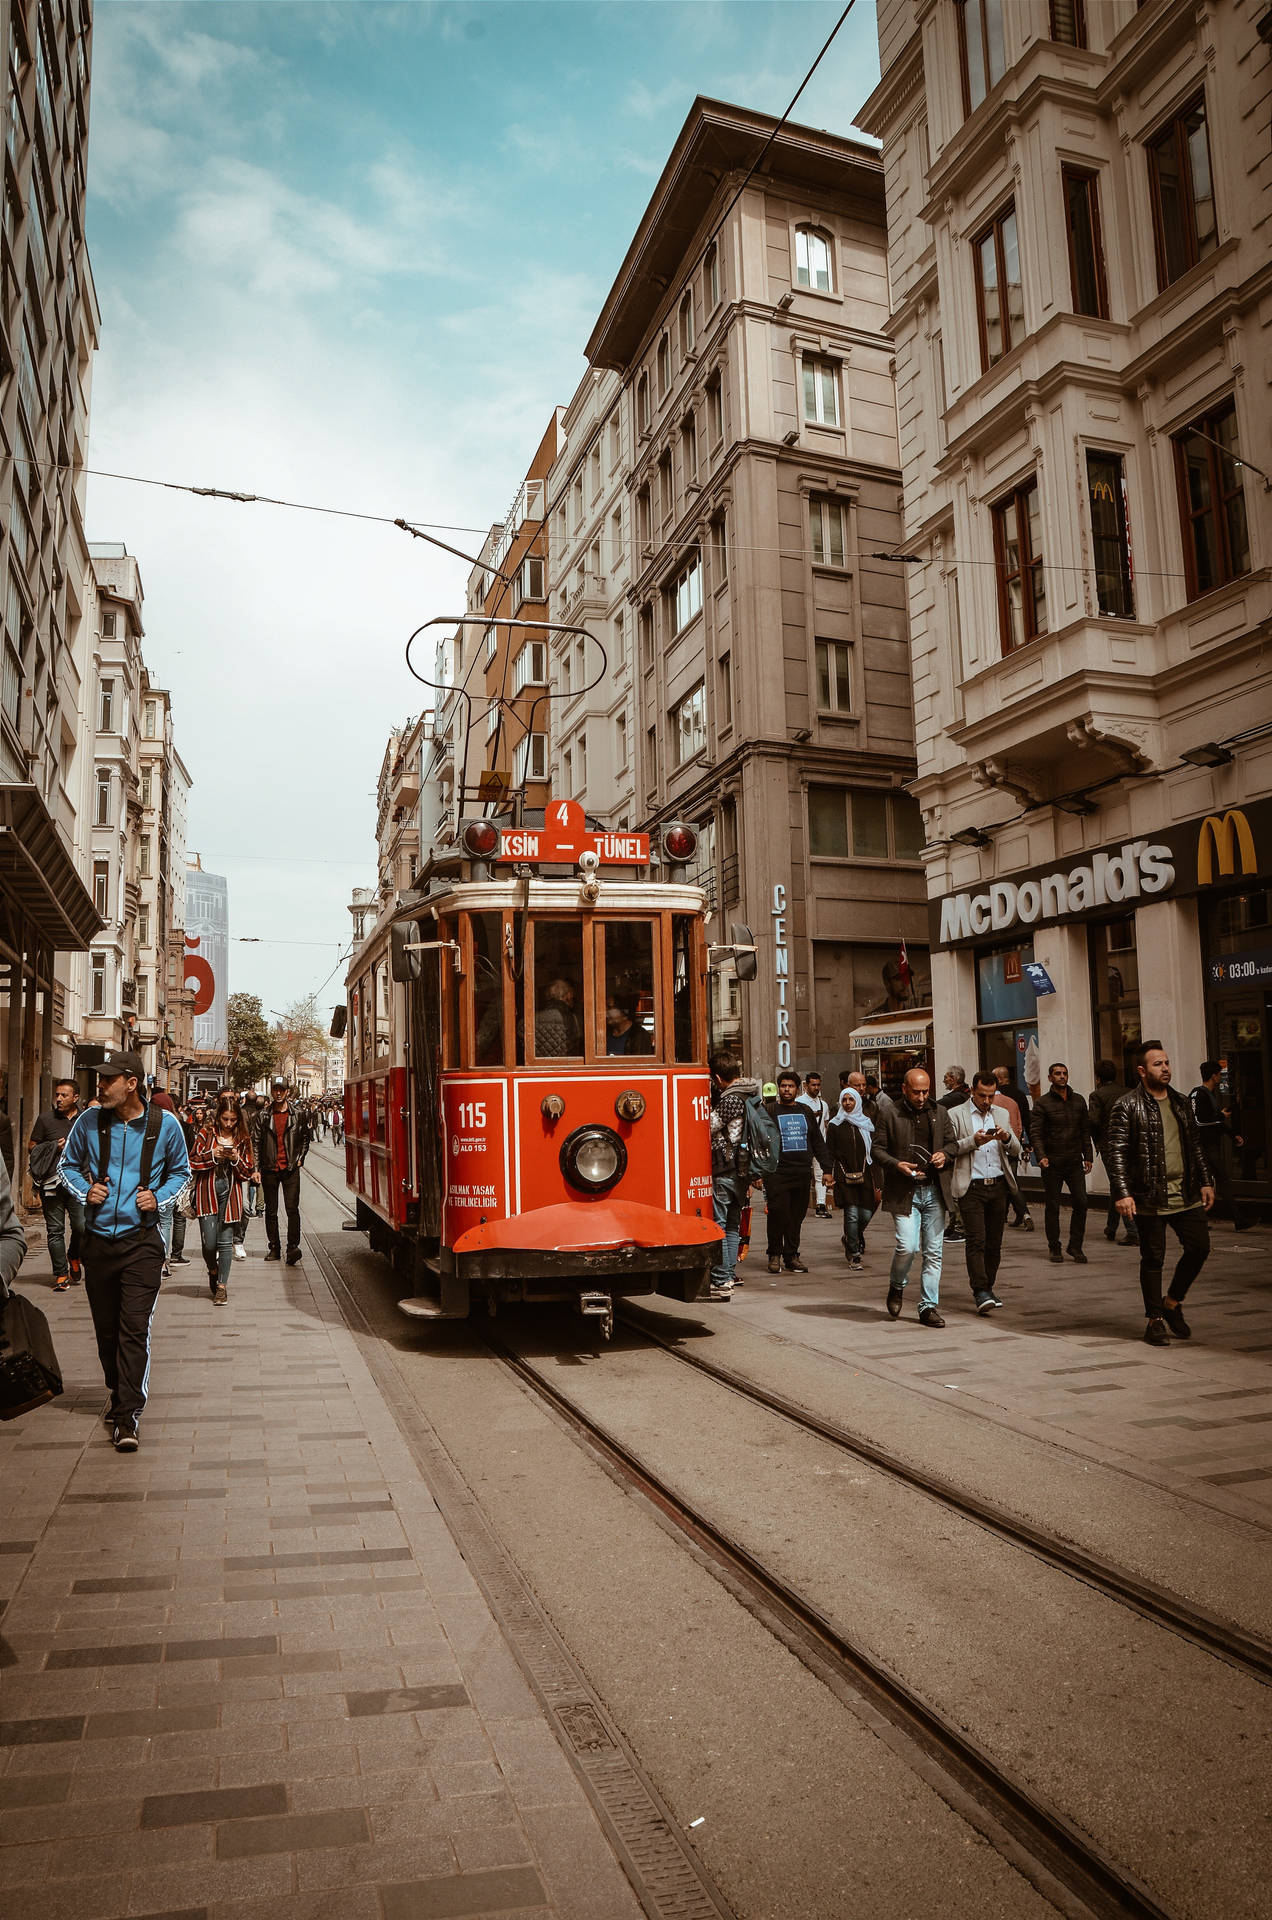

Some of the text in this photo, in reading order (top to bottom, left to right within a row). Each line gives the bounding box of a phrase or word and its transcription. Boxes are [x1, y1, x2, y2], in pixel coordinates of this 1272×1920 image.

[556, 802, 569, 826] 4
[501, 832, 539, 857] KSİM
[594, 834, 647, 859] TÜNEL
[939, 840, 1176, 943] McDonald's
[773, 884, 791, 1068] CENTRO
[854, 1037, 875, 1047] YILDIZ
[876, 1035, 903, 1046] GAZETE
[458, 1102, 487, 1129] 115
[692, 1095, 710, 1121] 115
[460, 1144, 487, 1152] ALO 153
[472, 1185, 496, 1196] YASAK
